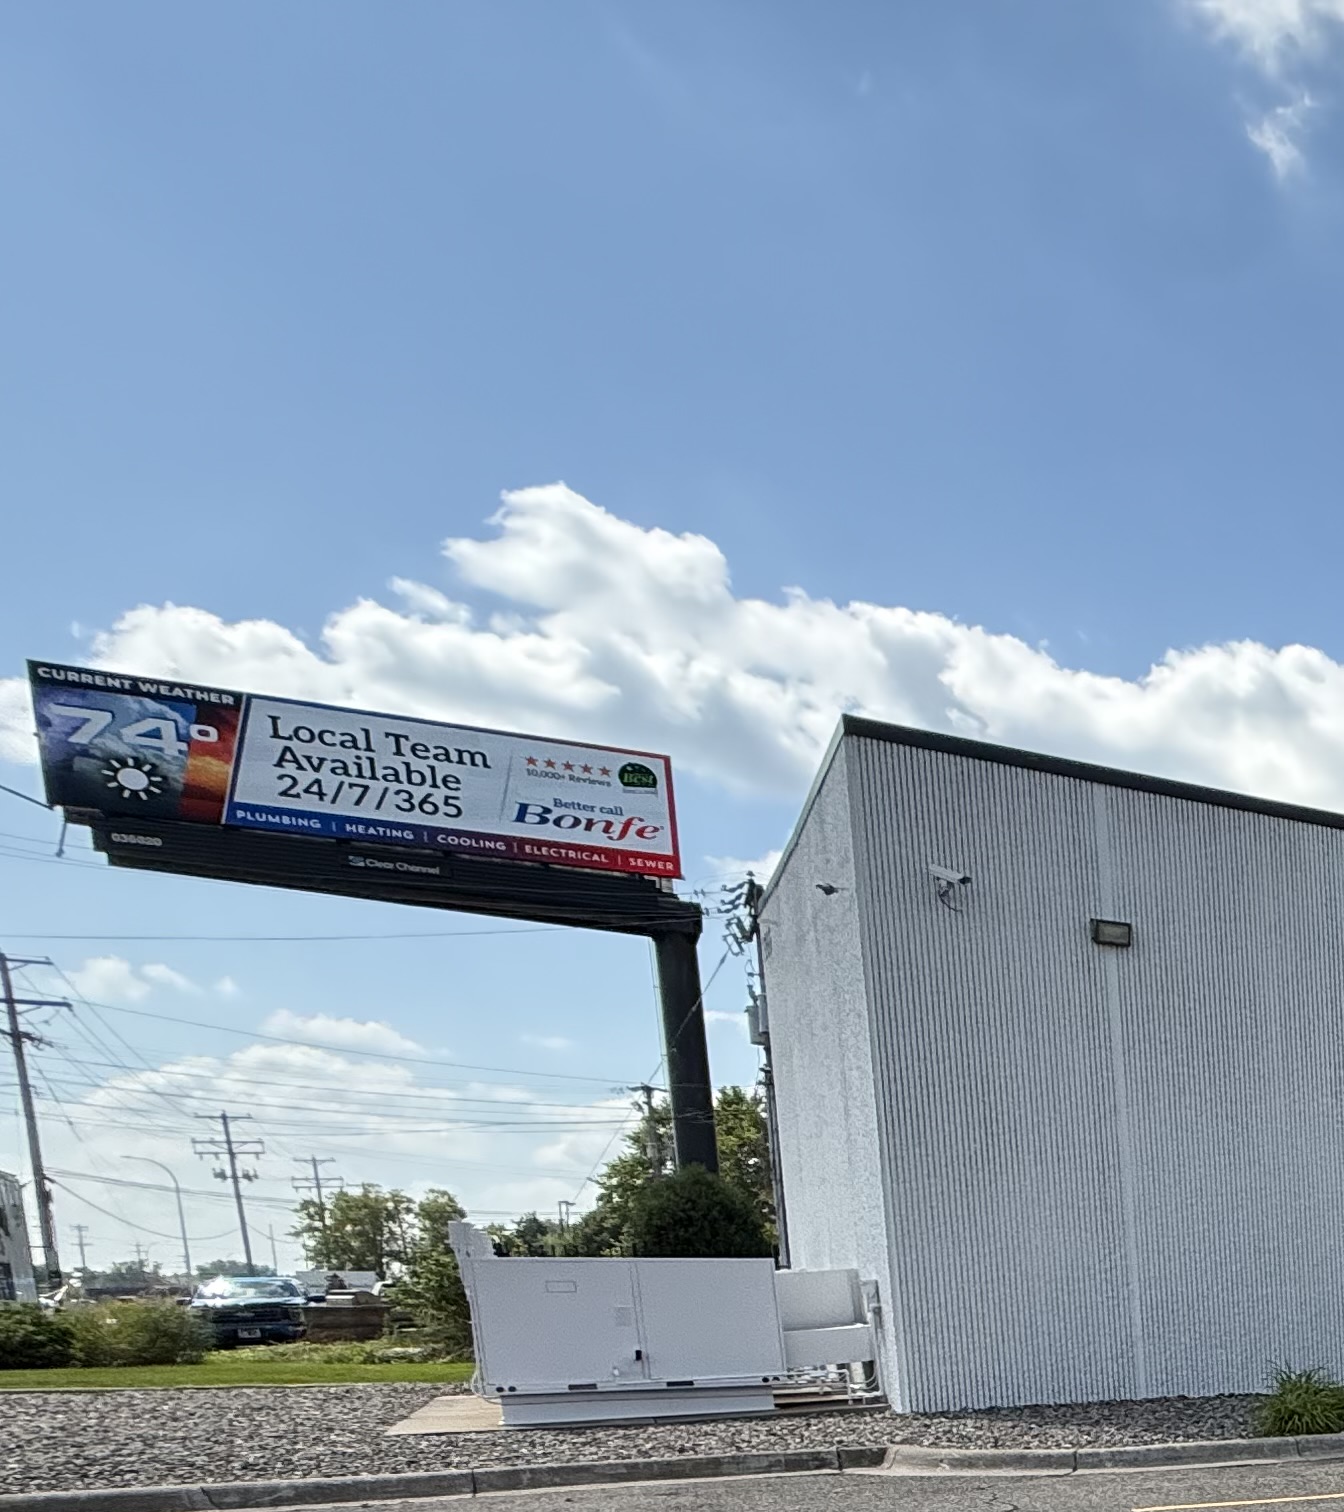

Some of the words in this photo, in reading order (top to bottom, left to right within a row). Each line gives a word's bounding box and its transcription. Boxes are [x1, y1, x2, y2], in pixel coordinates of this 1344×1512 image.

[37, 667, 133, 690] CURRENT
[138, 681, 234, 705] WEATHER
[267, 715, 376, 752] Local
[384, 732, 492, 769] Team
[273, 746, 462, 791] Available
[568, 774, 612, 787] Reviews
[277, 774, 463, 818] 24/7/365
[553, 798, 595, 813] Better
[600, 805, 624, 816] call
[236, 810, 321, 829] PLUMBING
[345, 823, 414, 840] HEATING
[437, 834, 506, 851] COOLING
[525, 845, 609, 863] ELECTRICAL
[629, 857, 674, 871] SEWER
[512, 801, 660, 841] Bonfe
[396, 862, 440, 875] Channel
